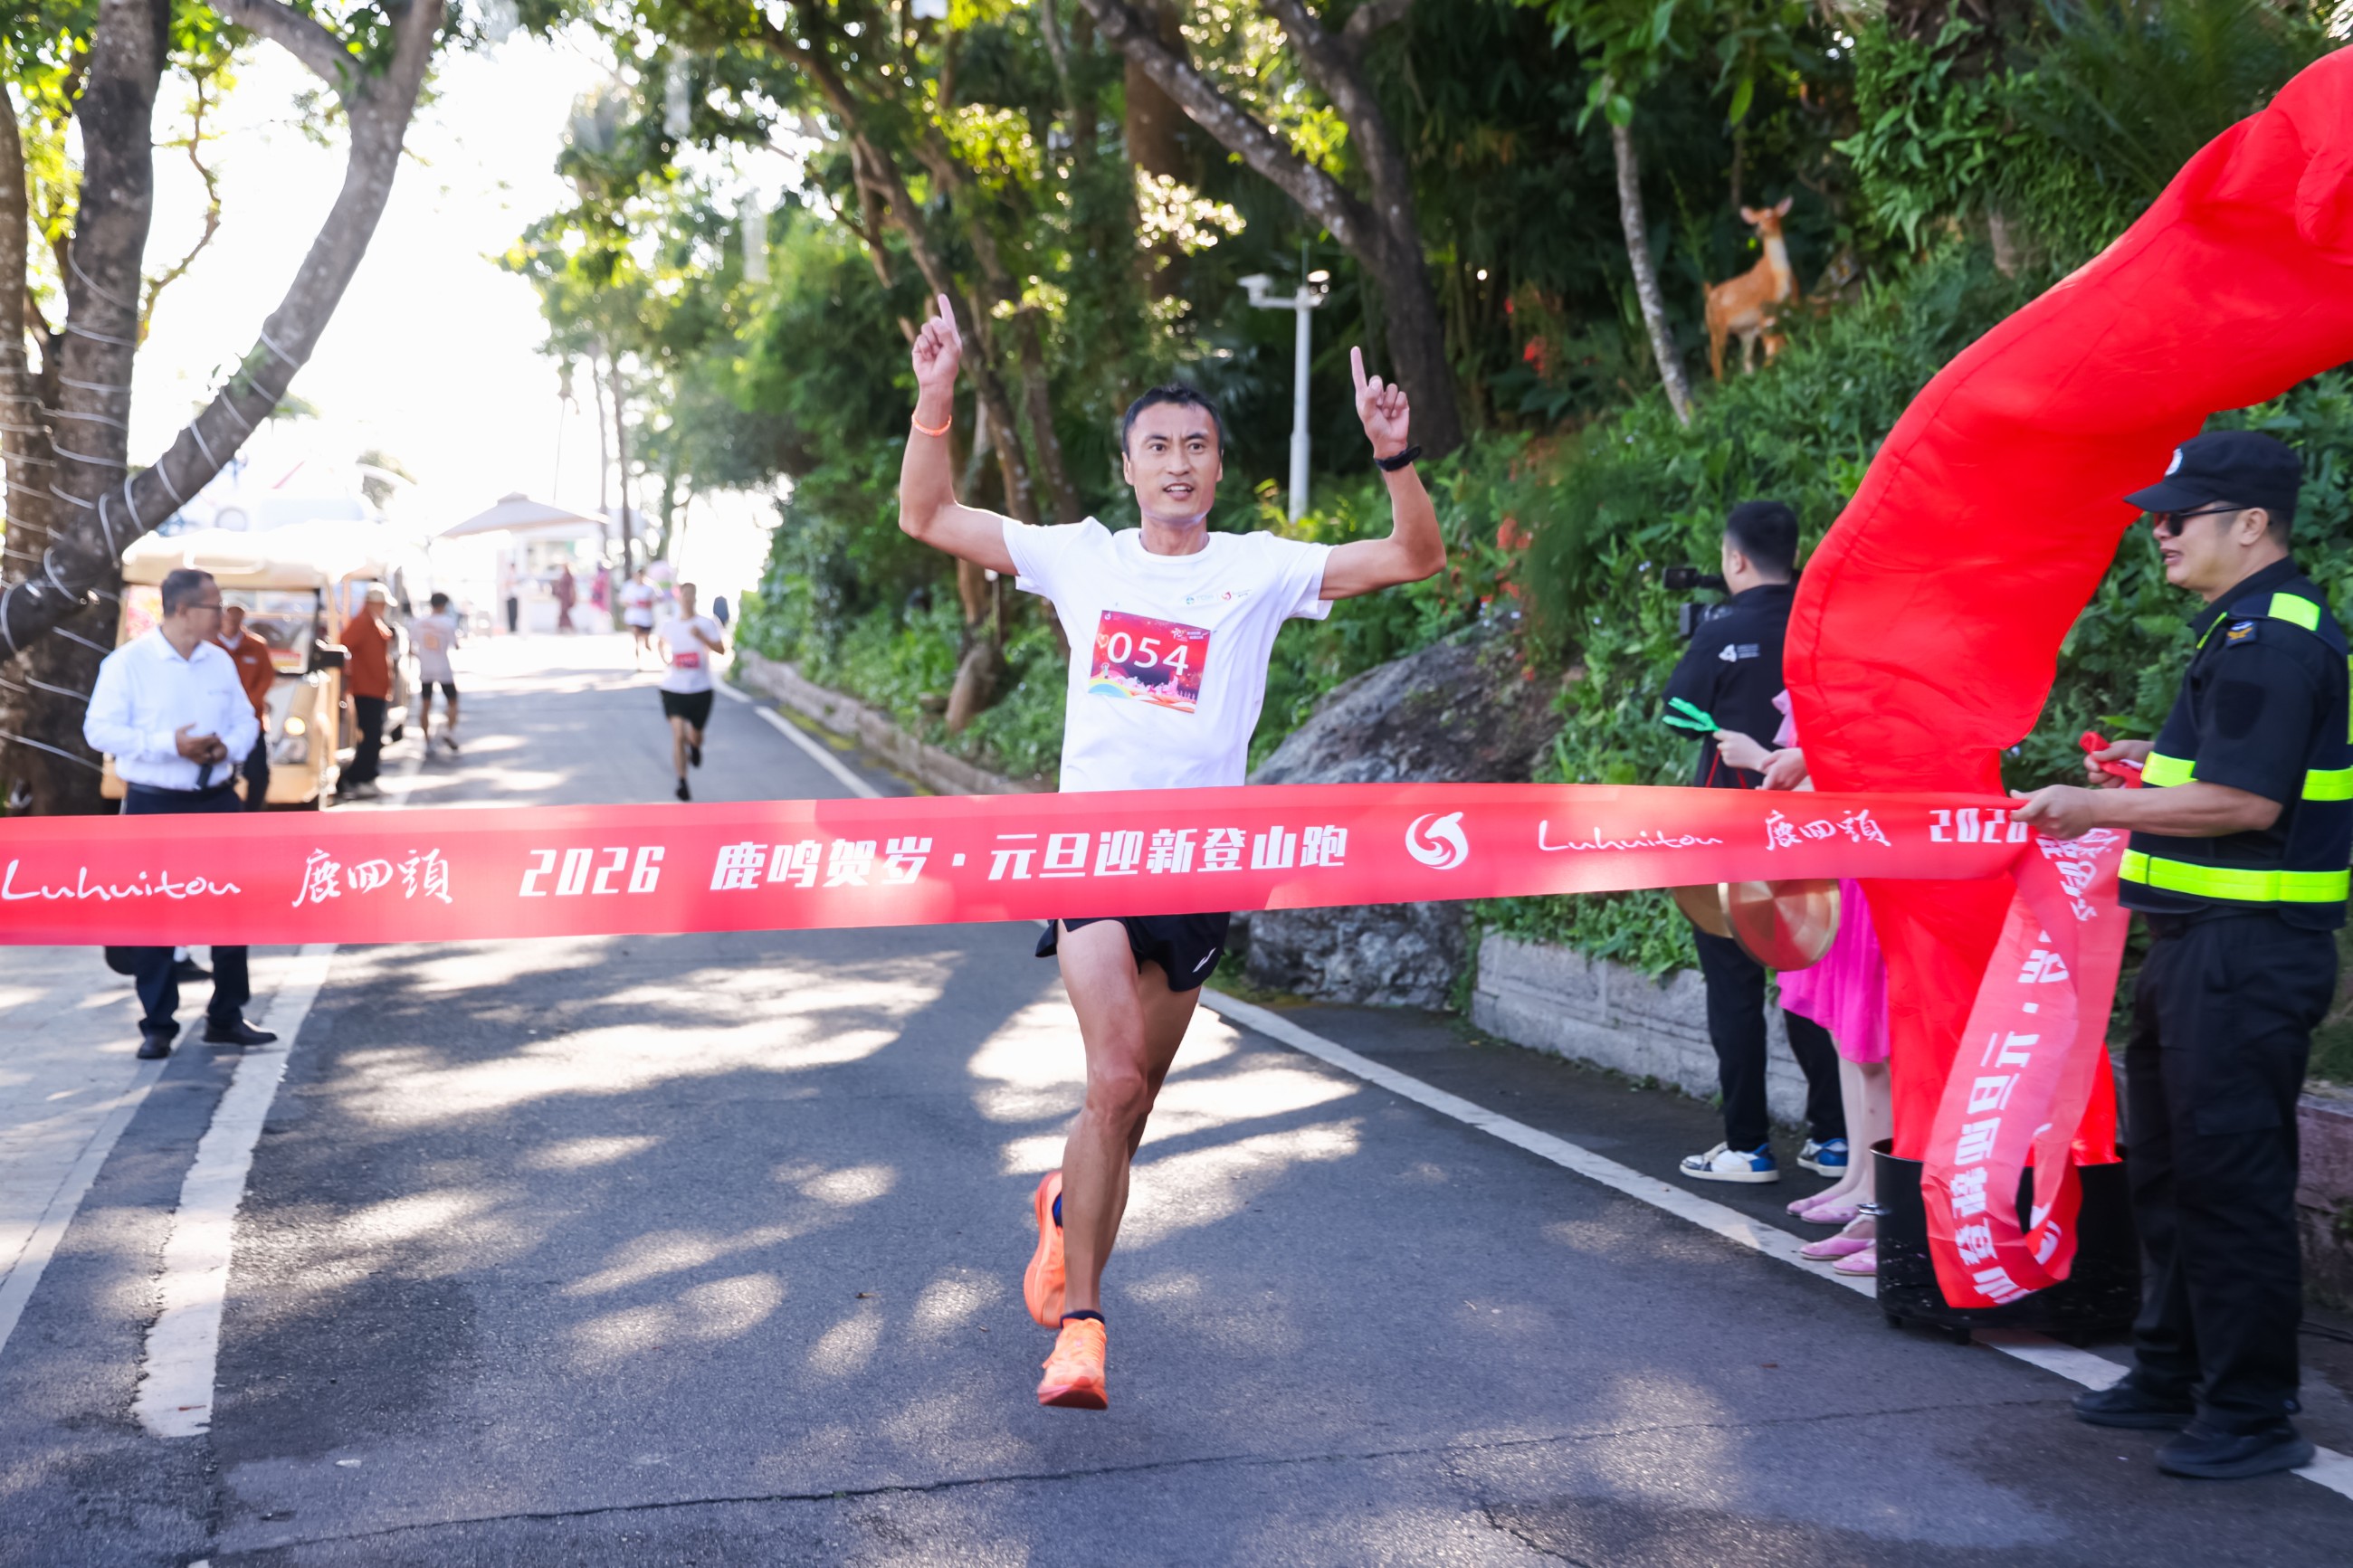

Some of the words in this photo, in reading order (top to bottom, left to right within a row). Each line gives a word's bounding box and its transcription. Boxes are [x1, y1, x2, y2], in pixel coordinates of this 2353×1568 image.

[1107, 632, 1189, 676] 054
[2, 860, 241, 901] Luhuitou
[519, 846, 665, 897] 2026
[1538, 819, 1722, 852] Luhuitou
